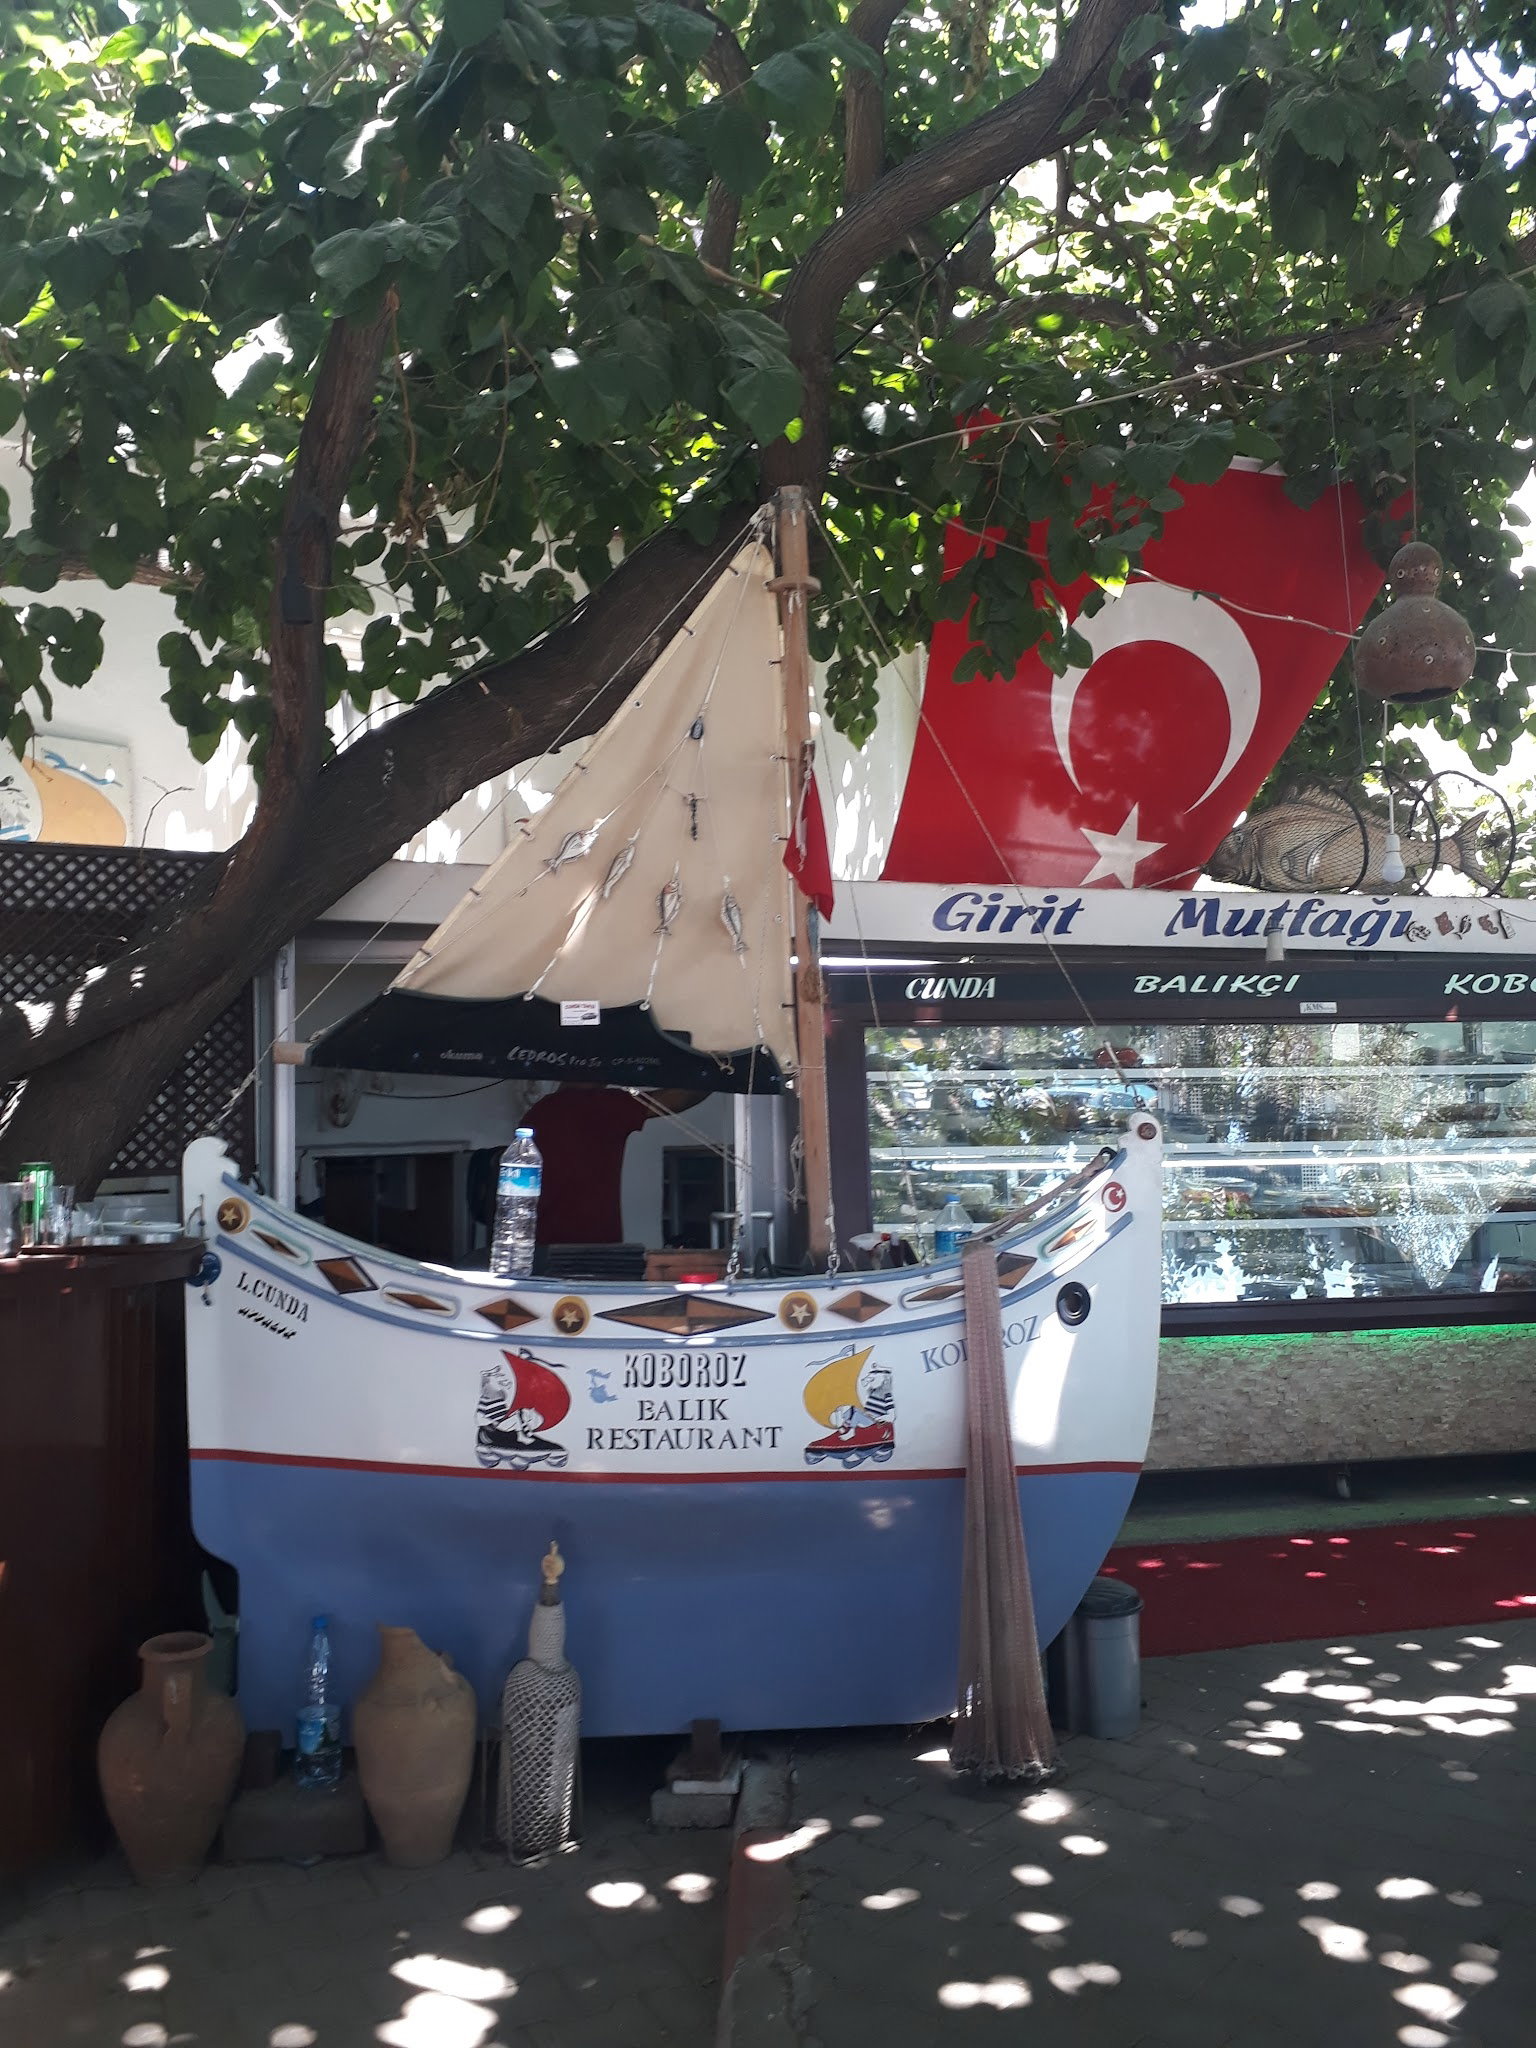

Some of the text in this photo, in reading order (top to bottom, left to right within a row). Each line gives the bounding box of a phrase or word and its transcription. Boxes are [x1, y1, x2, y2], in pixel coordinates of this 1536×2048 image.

[932, 892, 1412, 947] Girit Mutfağı
[905, 973, 1536, 999] CUNDA BALIKÇI KOB
[623, 1353, 748, 1388] KOBOROZ
[636, 1398, 729, 1421] BALIK
[586, 1426, 784, 1450] RESTAURANT
